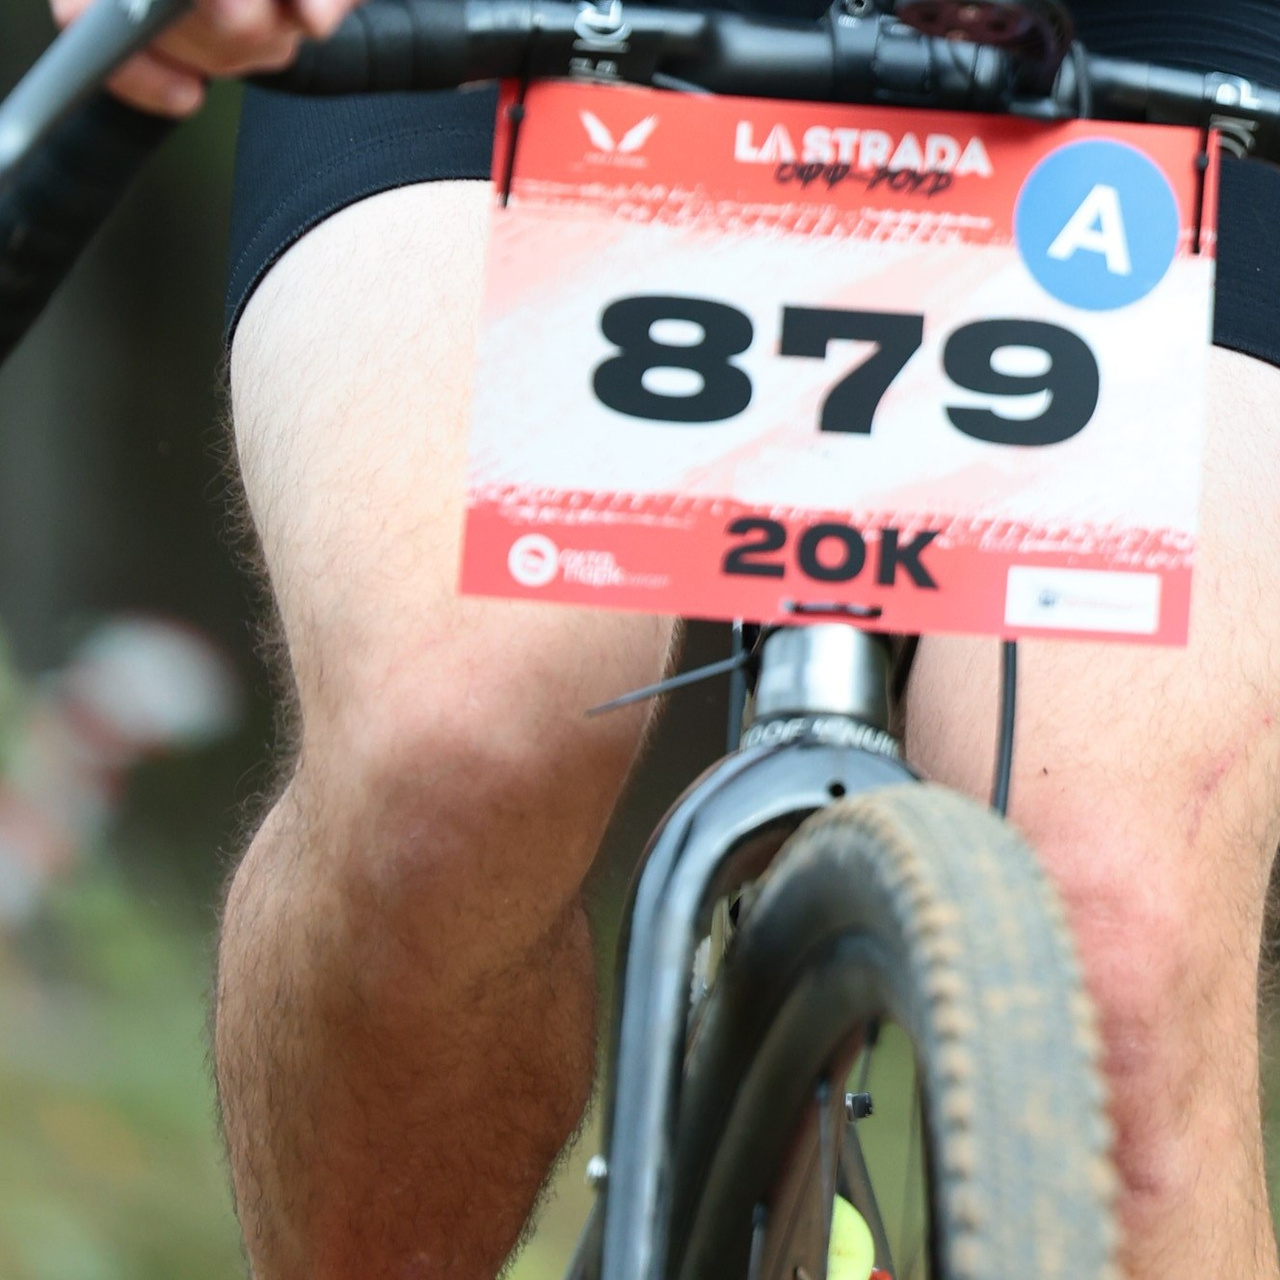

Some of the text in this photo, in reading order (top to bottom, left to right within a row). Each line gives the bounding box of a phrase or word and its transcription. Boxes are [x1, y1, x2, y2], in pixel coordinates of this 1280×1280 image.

[733, 120, 995, 179] LA STRADA
[1046, 183, 1133, 277] A
[591, 295, 1100, 447] 879
[722, 517, 939, 590] 20K
